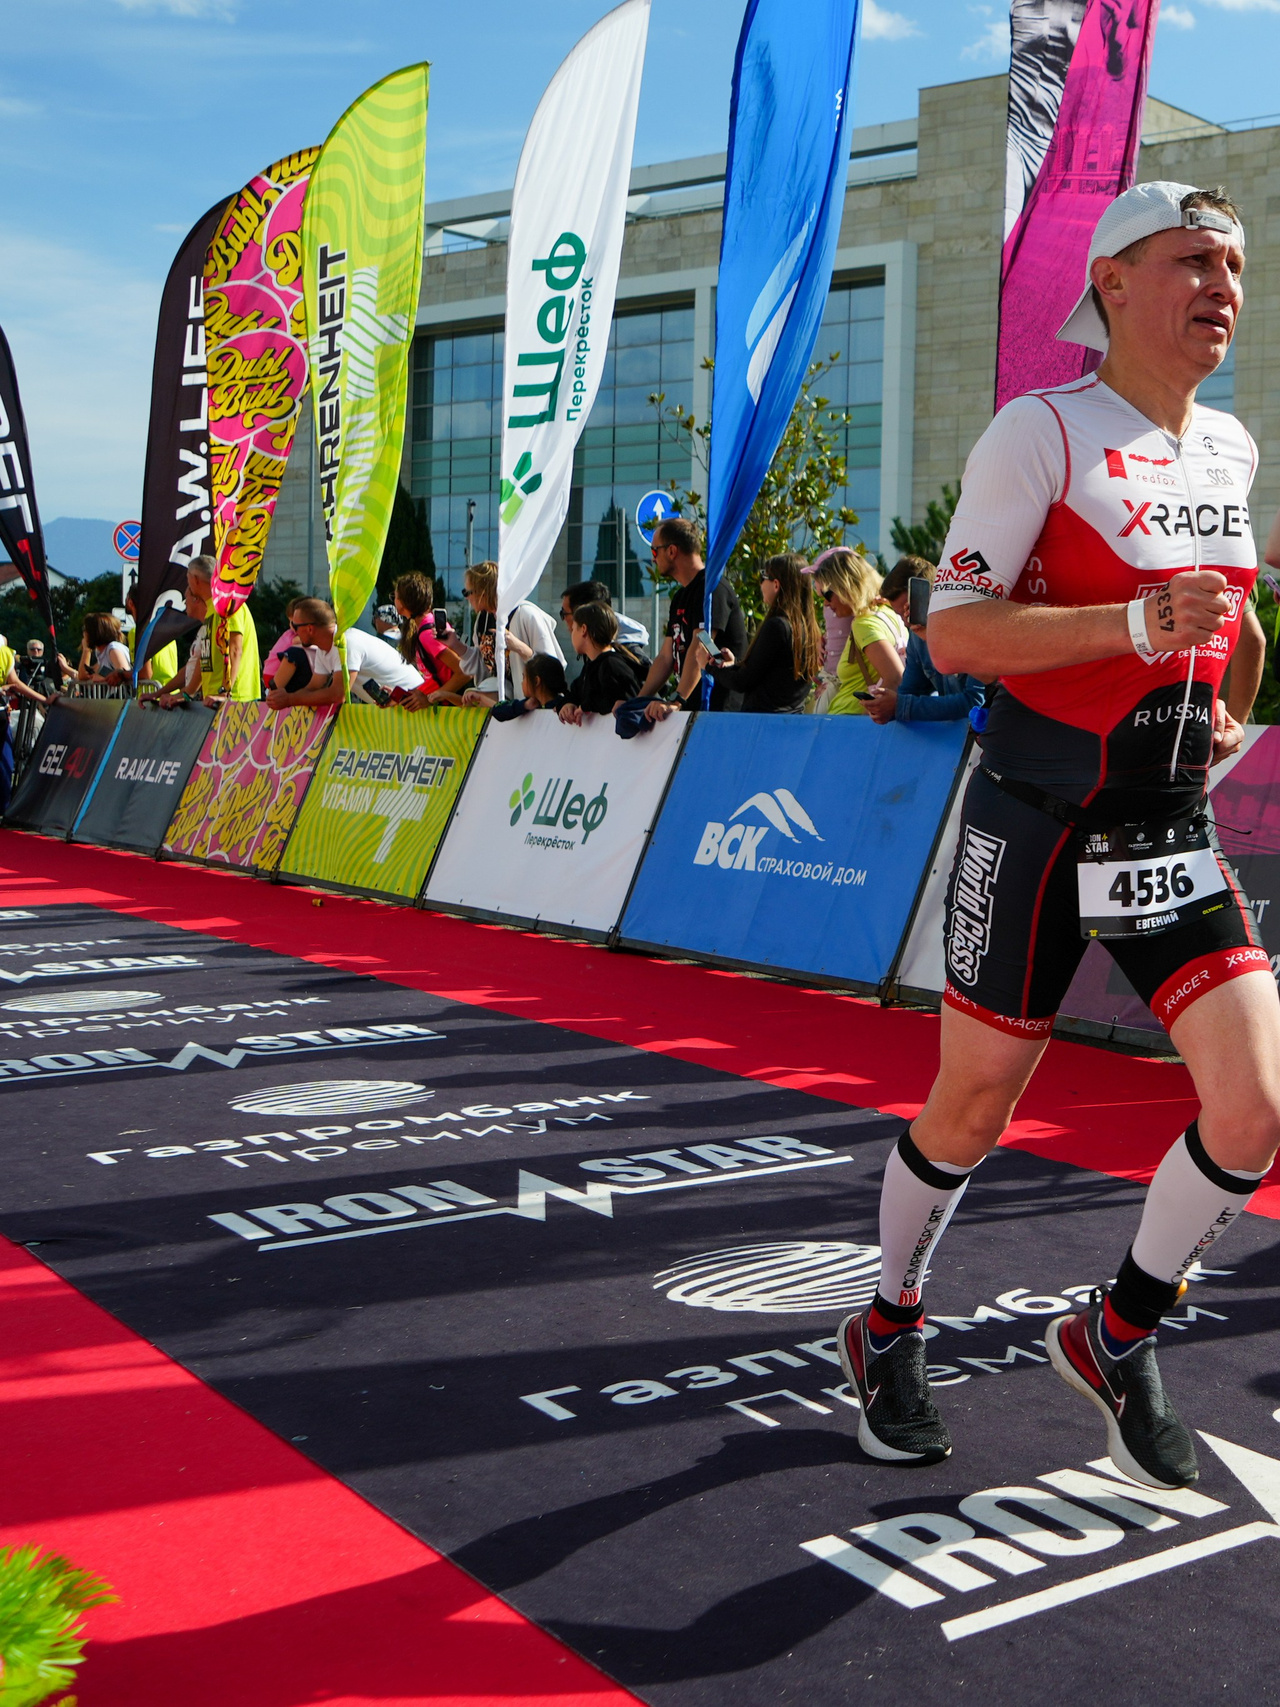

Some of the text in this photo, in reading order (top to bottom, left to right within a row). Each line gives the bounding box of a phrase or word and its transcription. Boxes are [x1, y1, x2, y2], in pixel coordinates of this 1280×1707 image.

[507, 231, 587, 429] Шеф
[566, 276, 594, 422] Перекрёсток
[1135, 473, 1177, 487] redfox
[1206, 468, 1234, 486] SGS
[934, 569, 1005, 599] SINARA
[1133, 703, 1209, 727] RUSSIA
[39, 744, 94, 779] GEL 4U
[328, 748, 456, 789] FAHRENHEIT
[321, 782, 377, 814] VITAMIN
[532, 778, 608, 845] Шеф
[524, 831, 576, 851] Перекрёсток
[693, 821, 867, 887] ВСК СТРАХОВОЙ ДОМ
[950, 832, 998, 981] World Class
[1108, 863, 1194, 908] 4536
[1135, 910, 1179, 931] ЕВГЕНИЙ
[32, 955, 198, 973] STAR
[1163, 969, 1211, 1015] XRACER
[0, 1023, 439, 1077] RON STAR
[87, 1090, 652, 1165] Газпромбанк
[221, 1111, 613, 1168] Премиум
[207, 1135, 836, 1241] IRON STAR
[800, 1455, 1231, 1610] IRON
